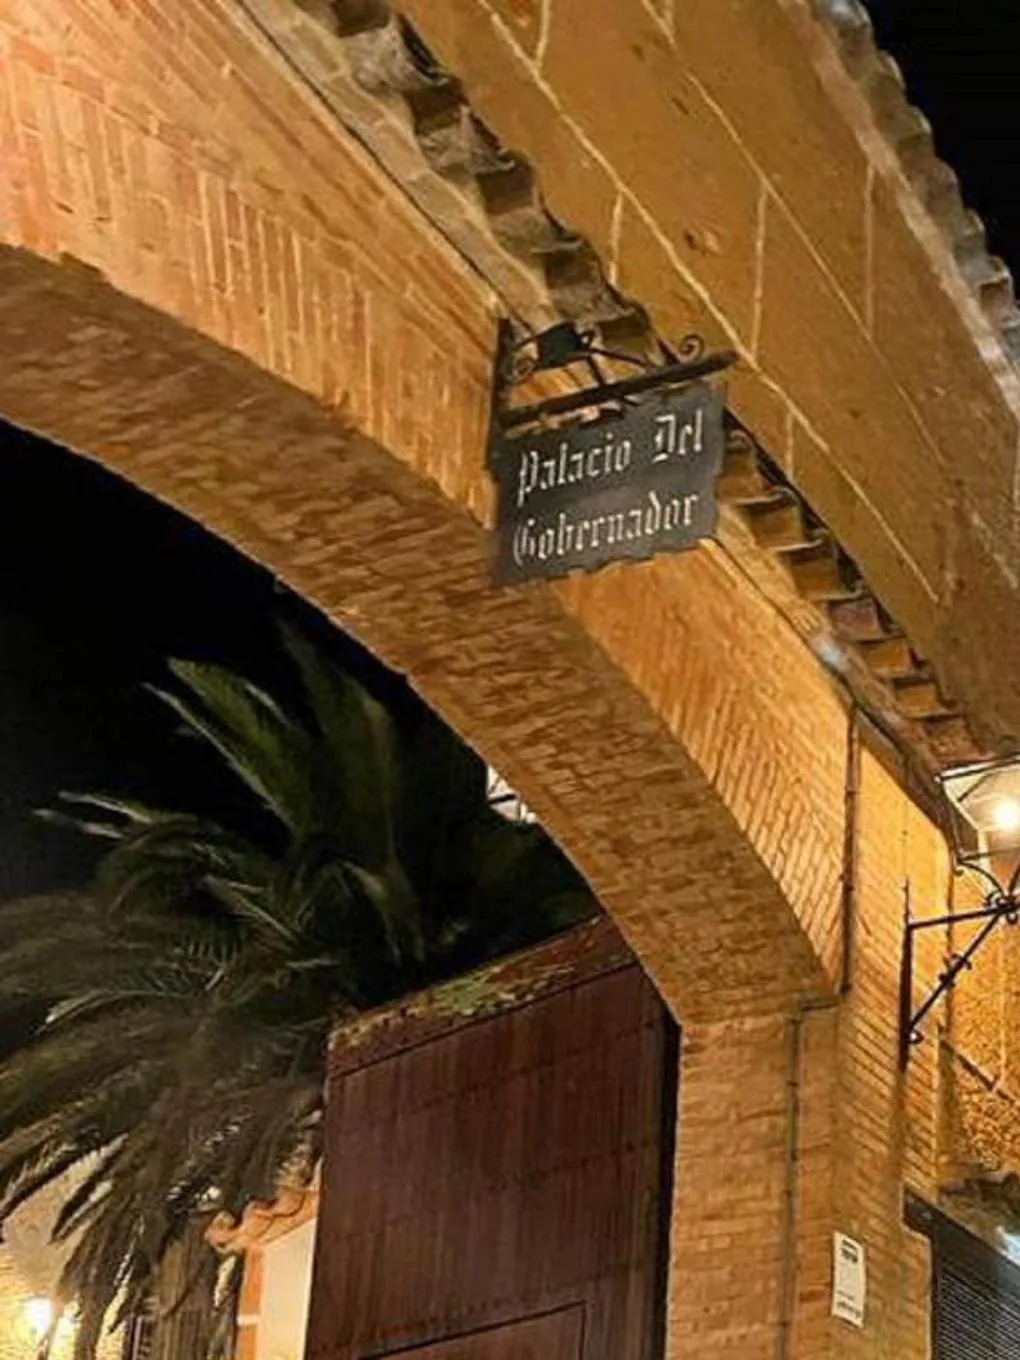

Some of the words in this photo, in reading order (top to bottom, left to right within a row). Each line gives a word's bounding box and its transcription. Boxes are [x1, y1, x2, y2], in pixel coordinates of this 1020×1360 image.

[517, 432, 631, 507] Palacio
[652, 408, 703, 463] Del
[513, 491, 699, 566] Gobernador
